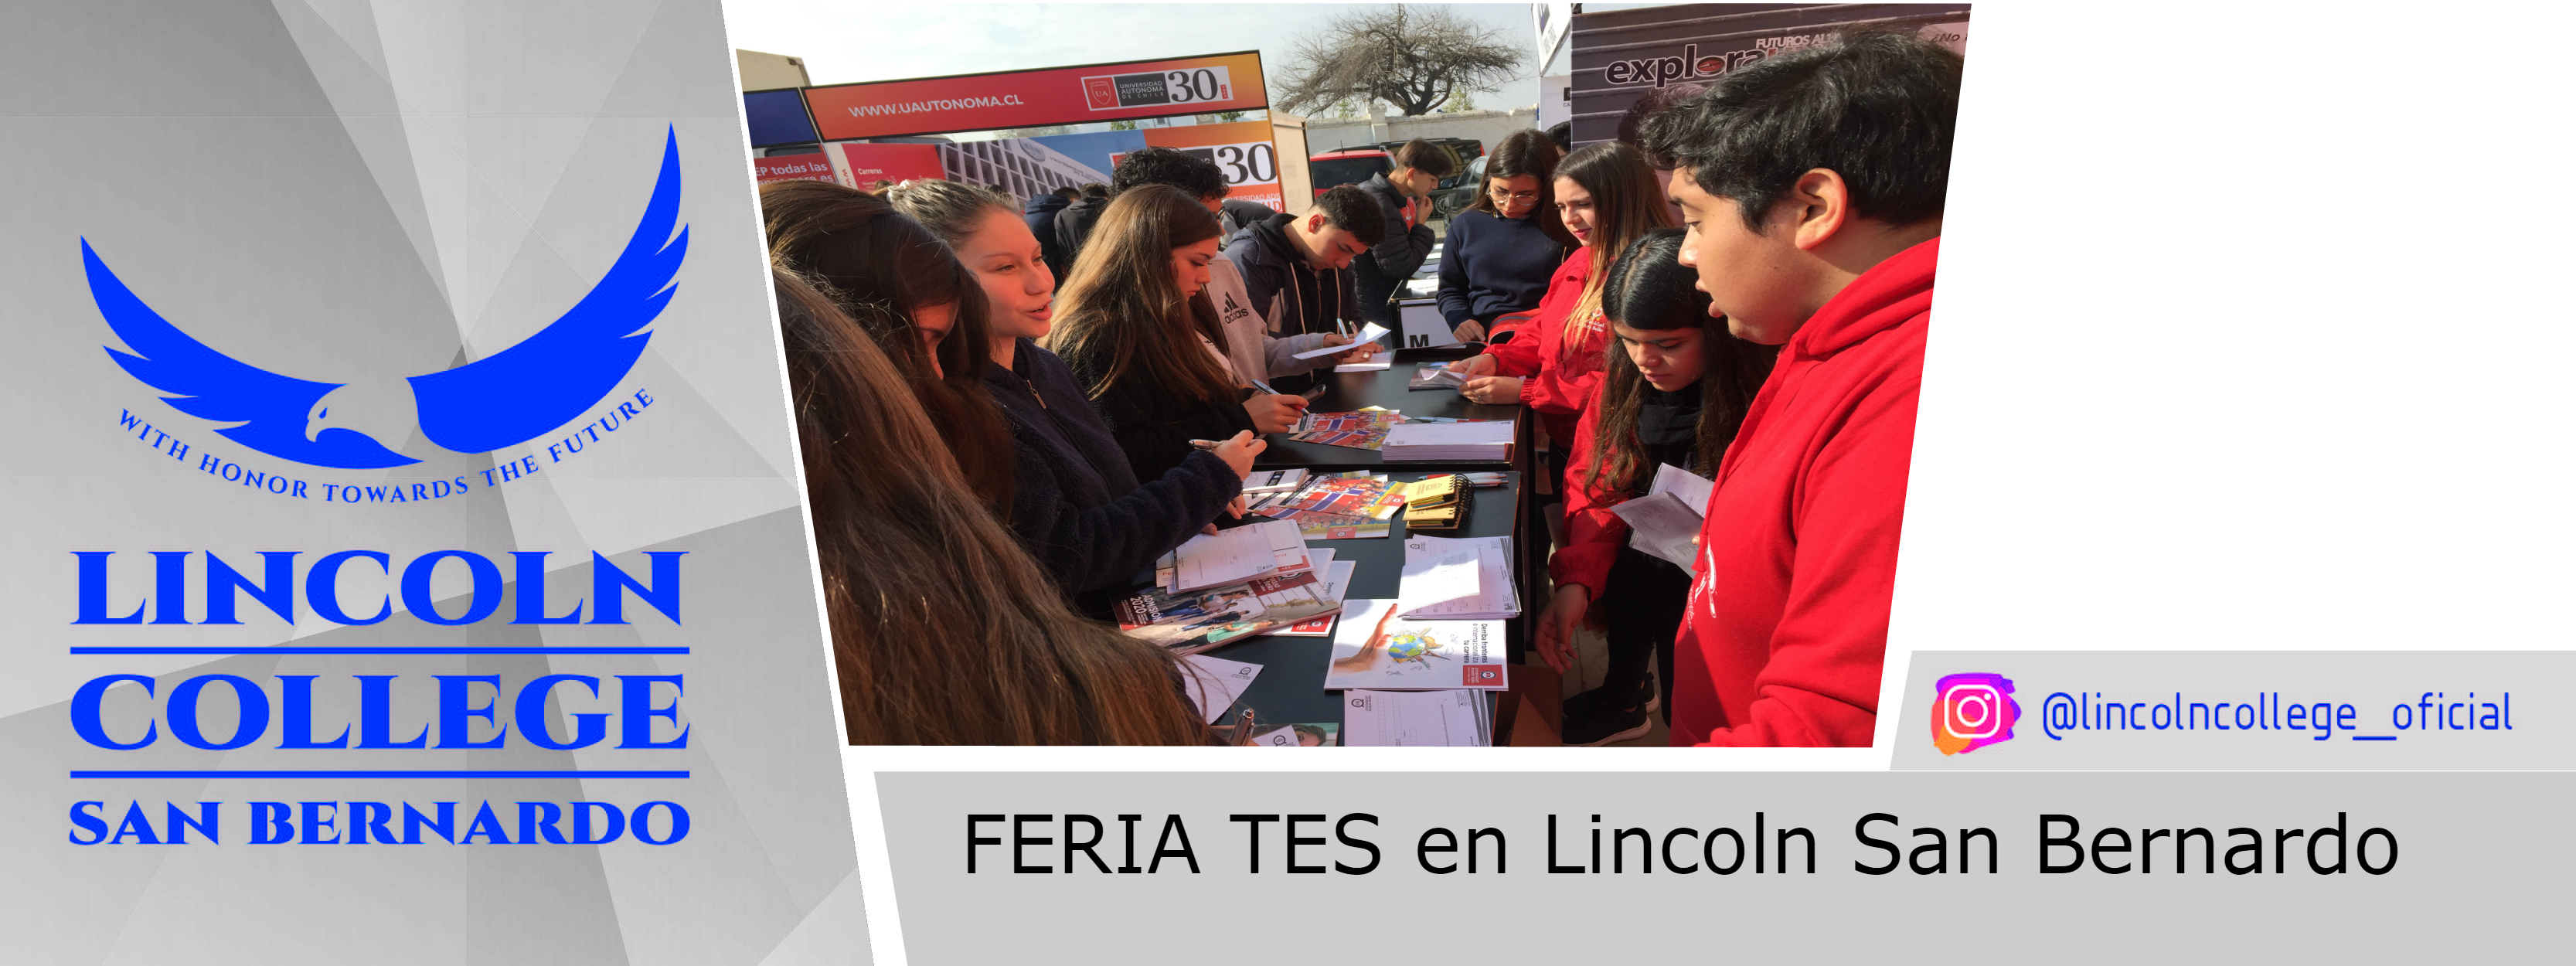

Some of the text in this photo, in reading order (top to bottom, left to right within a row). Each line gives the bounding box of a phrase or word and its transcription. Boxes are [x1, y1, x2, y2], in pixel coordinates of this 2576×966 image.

[1755, 35, 1811, 49] FUTUROS
[1119, 80, 1163, 89] UNIVERSIDAD
[1121, 86, 1165, 95] AUTONOMA
[1168, 69, 1219, 103] 30
[848, 94, 1024, 117] WWW.UAUTONOMA.CL
[771, 164, 808, 175] todas
[808, 162, 828, 172] las
[1217, 144, 1278, 185] 30
[1224, 308, 1249, 325] adas
[1409, 334, 1429, 348] M
[1129, 596, 1147, 615] 2020
[1142, 594, 1162, 621] ADMISIÓN
